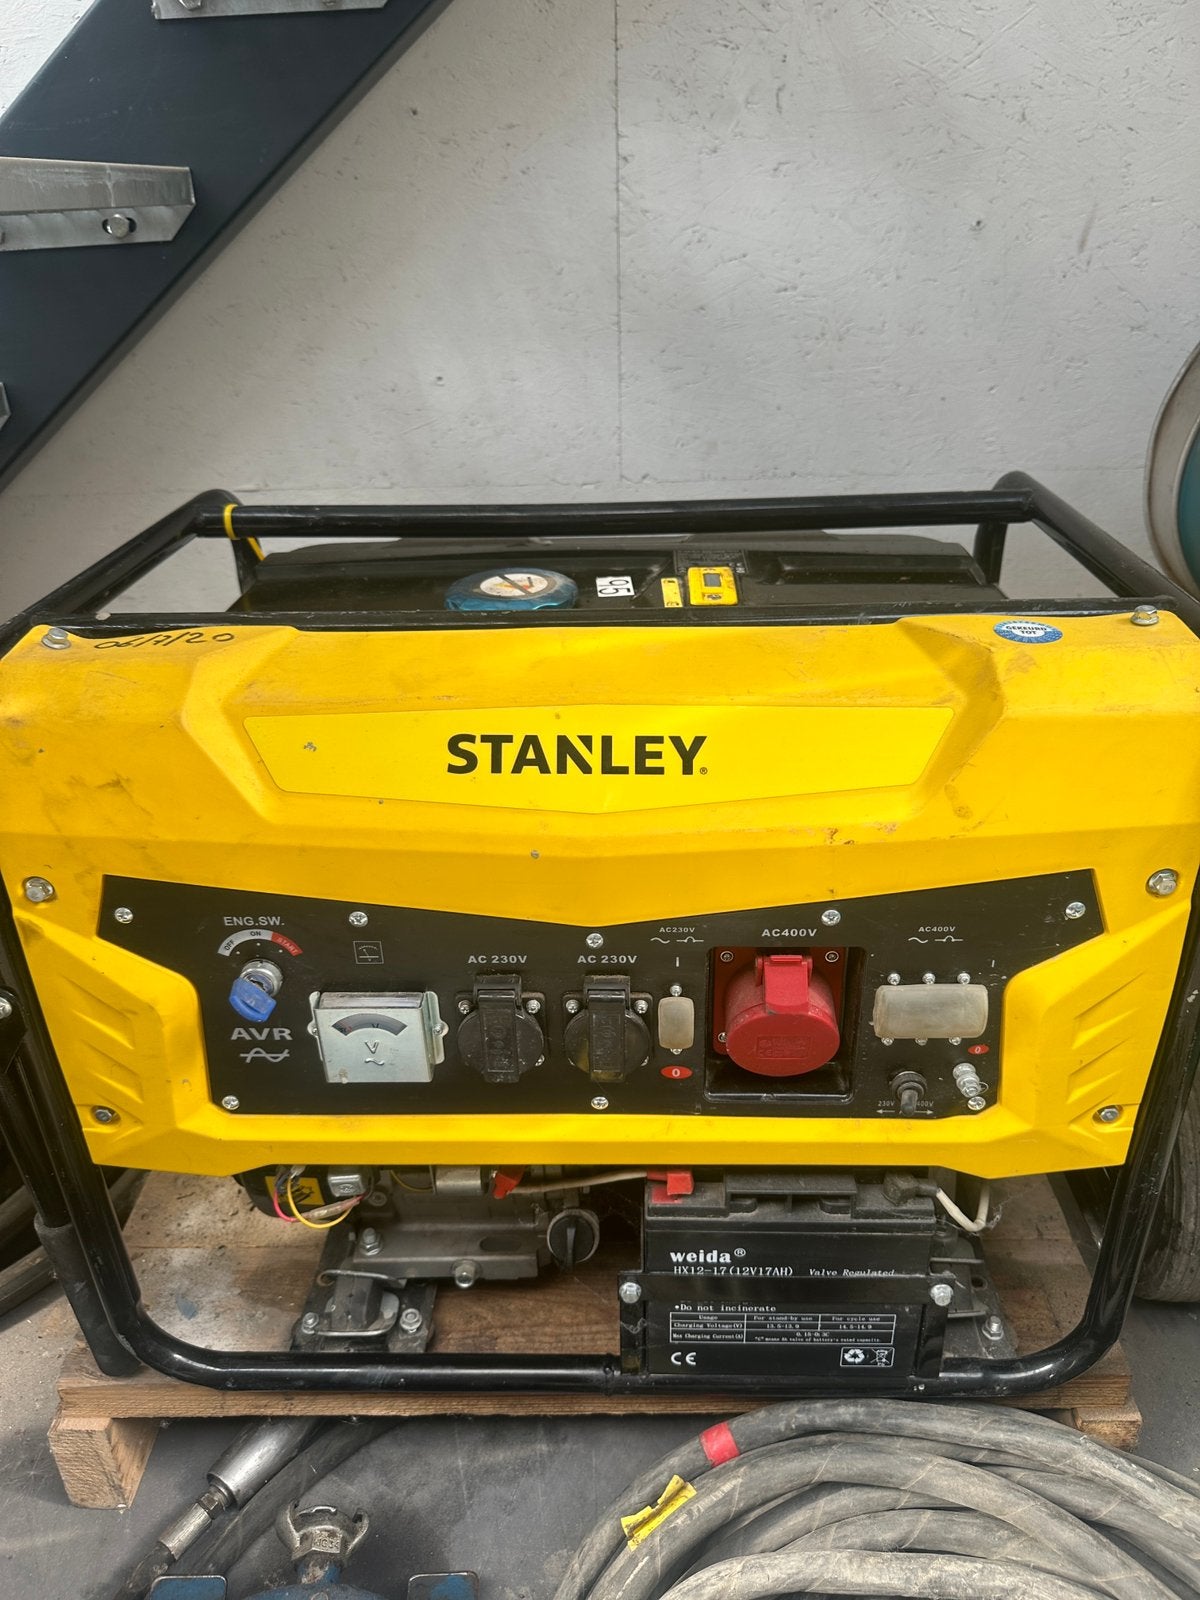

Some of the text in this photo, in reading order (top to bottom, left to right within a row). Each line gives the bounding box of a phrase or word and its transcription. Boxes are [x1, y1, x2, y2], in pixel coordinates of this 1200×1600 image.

[223, 916, 285, 927] ENG.SW.
[659, 926, 696, 934] AC230V
[761, 928, 817, 937] AC400V
[224, 939, 235, 951] OFF
[276, 936, 298, 954] START
[468, 955, 528, 964] AC 230V
[577, 955, 638, 965] AC 230V
[230, 1027, 293, 1041] AVR
[364, 1039, 381, 1054] V
[877, 1100, 896, 1108] 230V
[809, 1268, 896, 1278] Valve Regulated
[697, 1304, 714, 1312] not
[721, 1303, 777, 1312] incinerate
